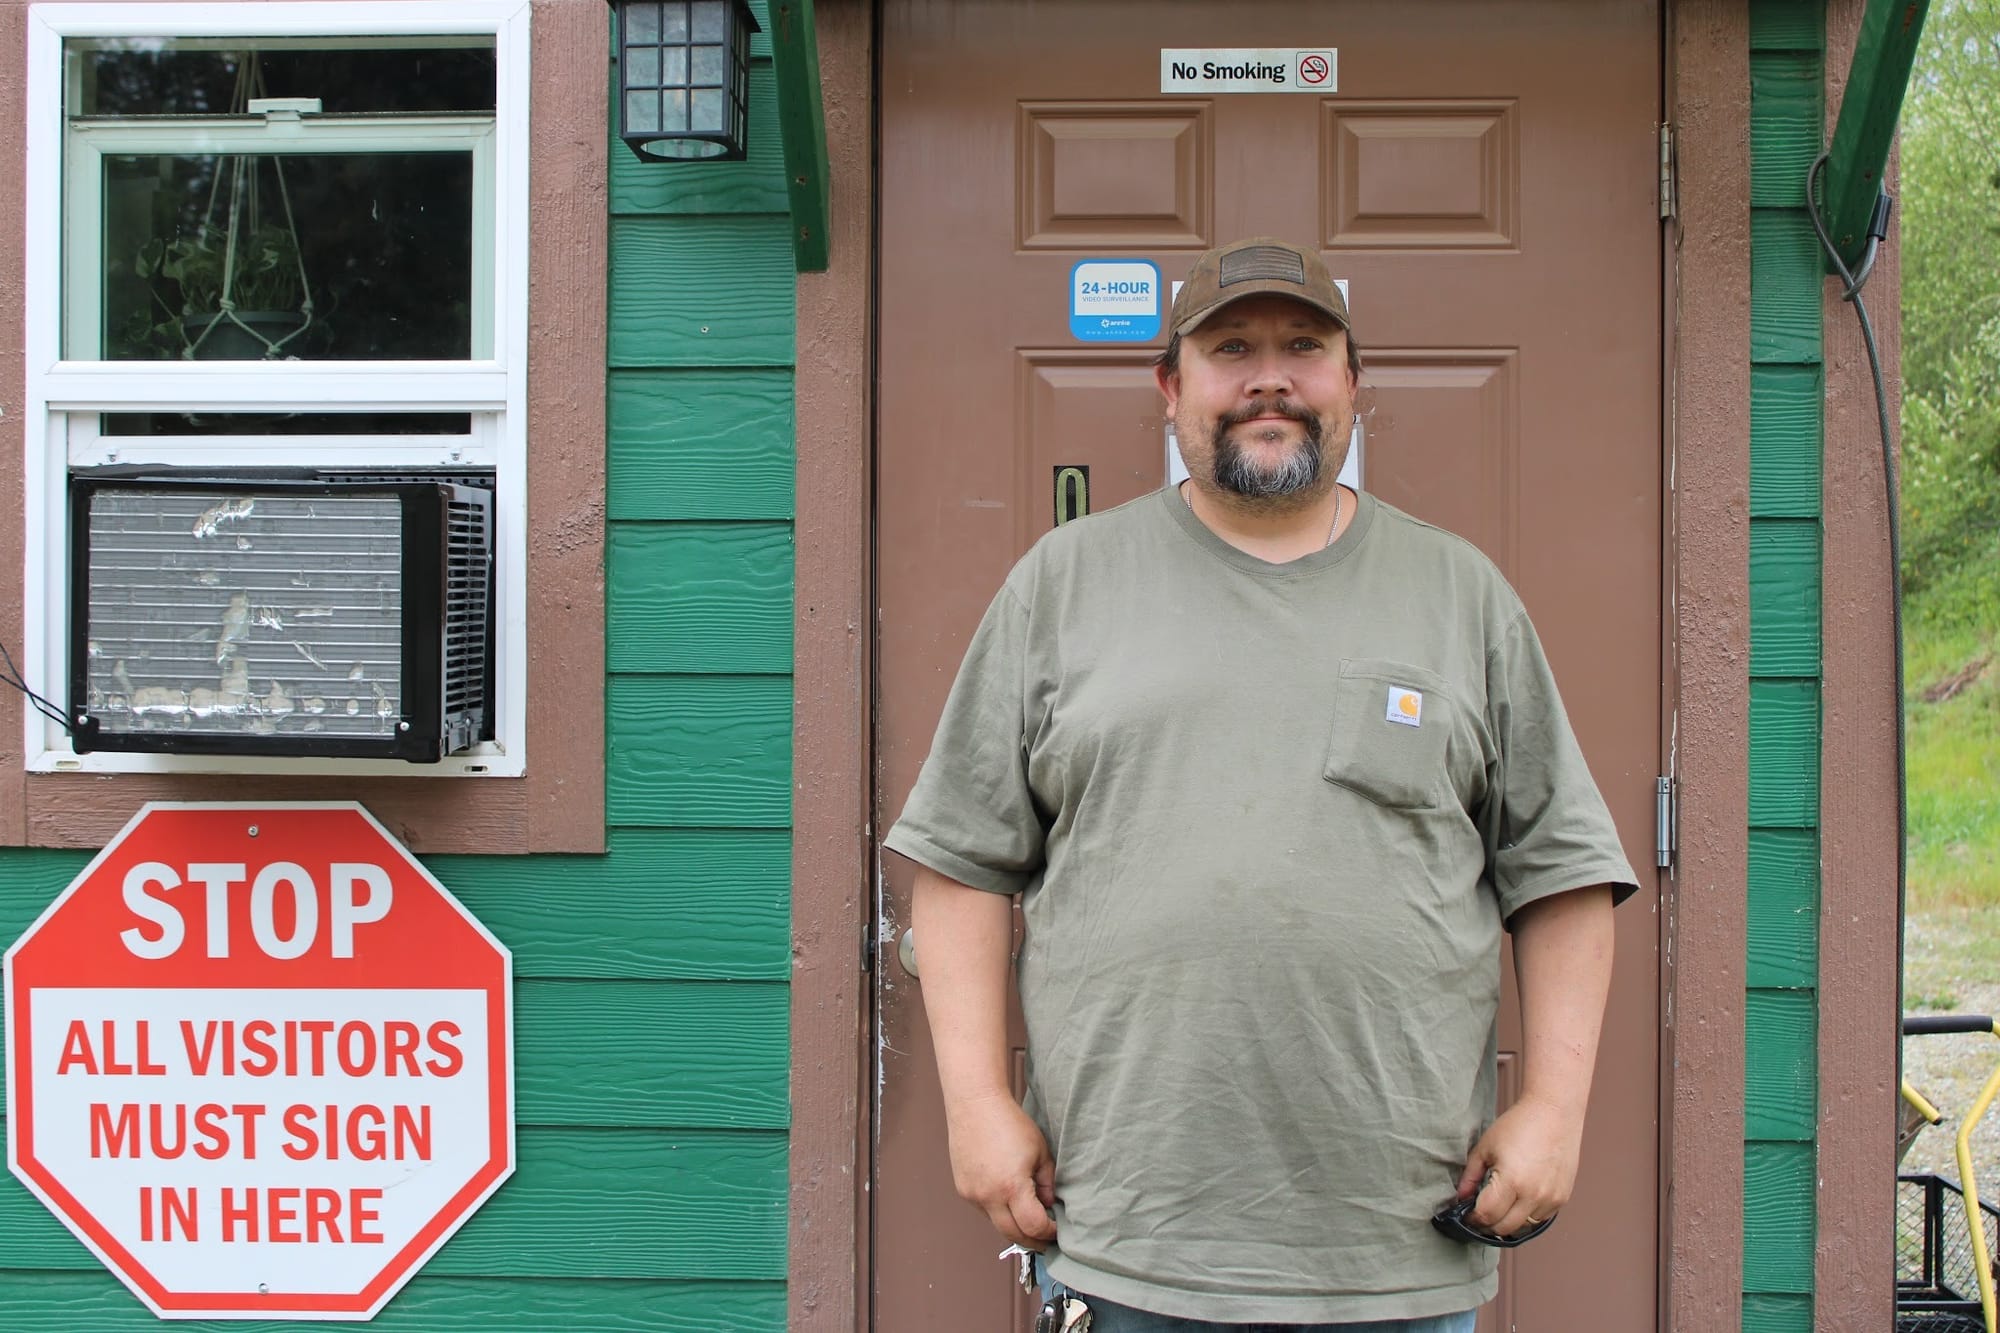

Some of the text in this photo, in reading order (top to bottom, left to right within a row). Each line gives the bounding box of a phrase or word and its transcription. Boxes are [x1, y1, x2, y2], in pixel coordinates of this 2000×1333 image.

[1171, 61, 1286, 84] No Smoking
[1081, 281, 1150, 295] 24-HOUR
[1081, 295, 1149, 303] VIDEO SURVEILLANCE
[120, 861, 394, 960] STOP
[57, 1019, 464, 1078] ALL VISITORS
[89, 1103, 432, 1161] MUST SIGN
[139, 1186, 385, 1244] IN HERE
